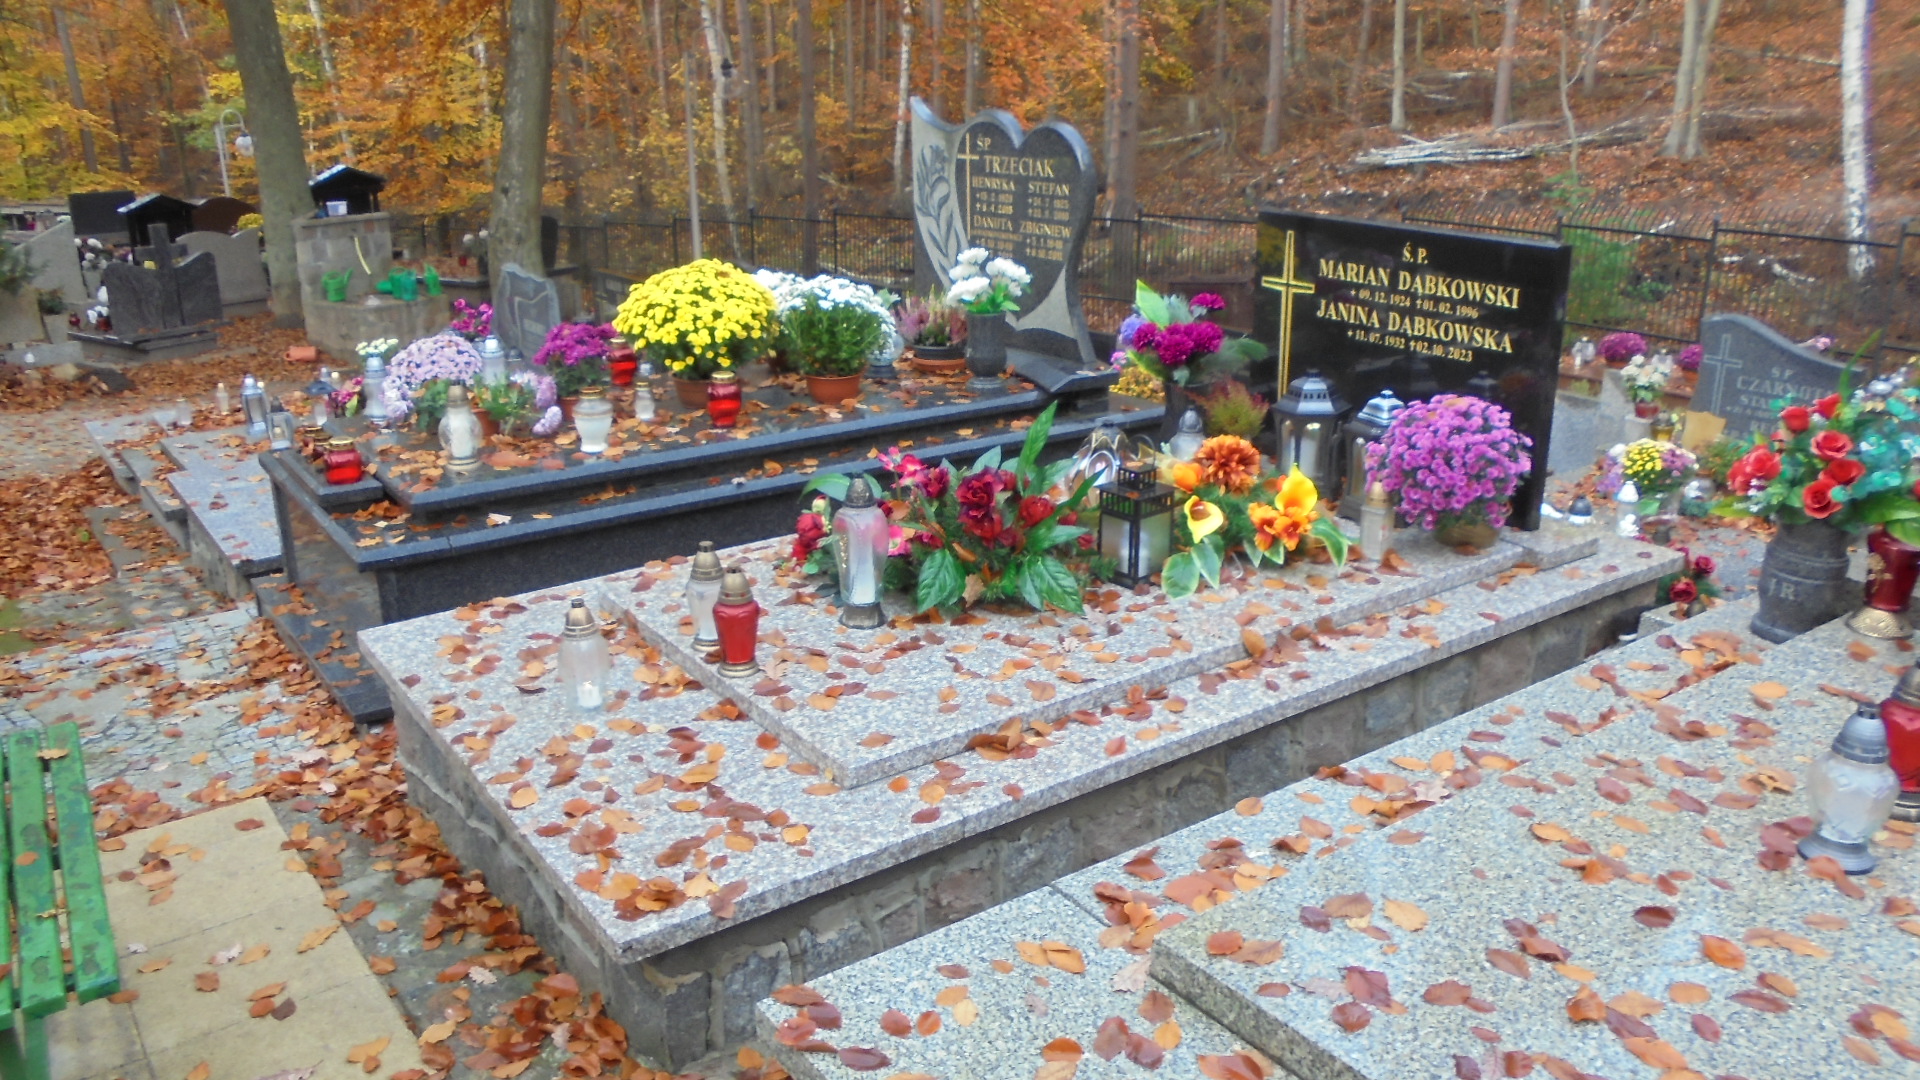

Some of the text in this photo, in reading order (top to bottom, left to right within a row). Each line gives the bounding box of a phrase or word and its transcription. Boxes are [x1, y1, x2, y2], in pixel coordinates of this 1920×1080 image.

[983, 155, 1055, 178] TRZECIAK
[1028, 182, 1070, 196] STEFAN
[973, 215, 1013, 231] DANUTA
[1020, 221, 1072, 238] ZBIGNIEW
[1319, 259, 1521, 309] MARIAN DĄBKOWSKI
[1316, 299, 1513, 353] JANINA DĄBKOWSKA
